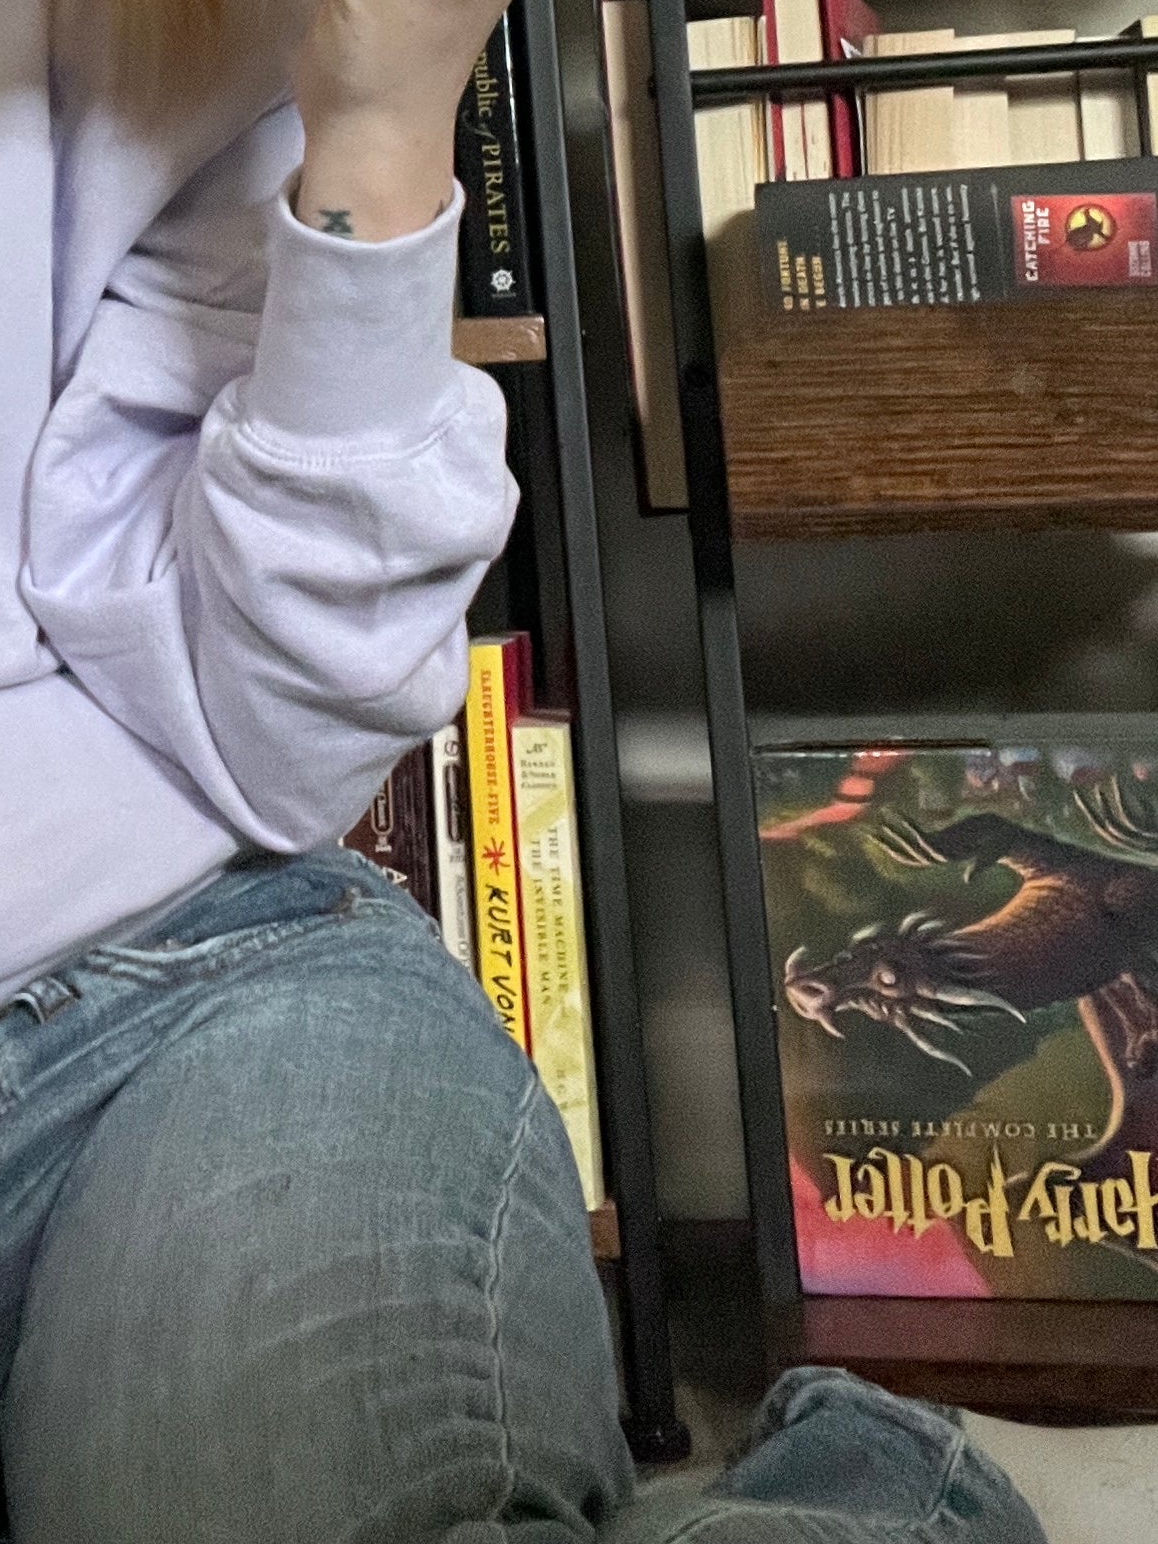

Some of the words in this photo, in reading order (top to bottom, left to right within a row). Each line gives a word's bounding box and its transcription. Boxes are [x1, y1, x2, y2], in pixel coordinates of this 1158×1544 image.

[473, 51, 499, 118] public
[481, 143, 510, 254] PIRATES
[1022, 200, 1039, 282] CATCHING
[1035, 207, 1051, 245] FIRE
[531, 840, 542, 871] THE
[547, 826, 560, 859] THE
[550, 866, 563, 908] TIME
[485, 883, 513, 968] KURT
[532, 878, 549, 963] INVISIBLE
[553, 913, 570, 994] MACHINE
[541, 970, 553, 1006] MAN
[823, 1118, 900, 1138] SERIES
[910, 1120, 1036, 1140] COMPLETE
[1046, 1121, 1097, 1140] THE
[823, 1143, 1015, 1257] Potter
